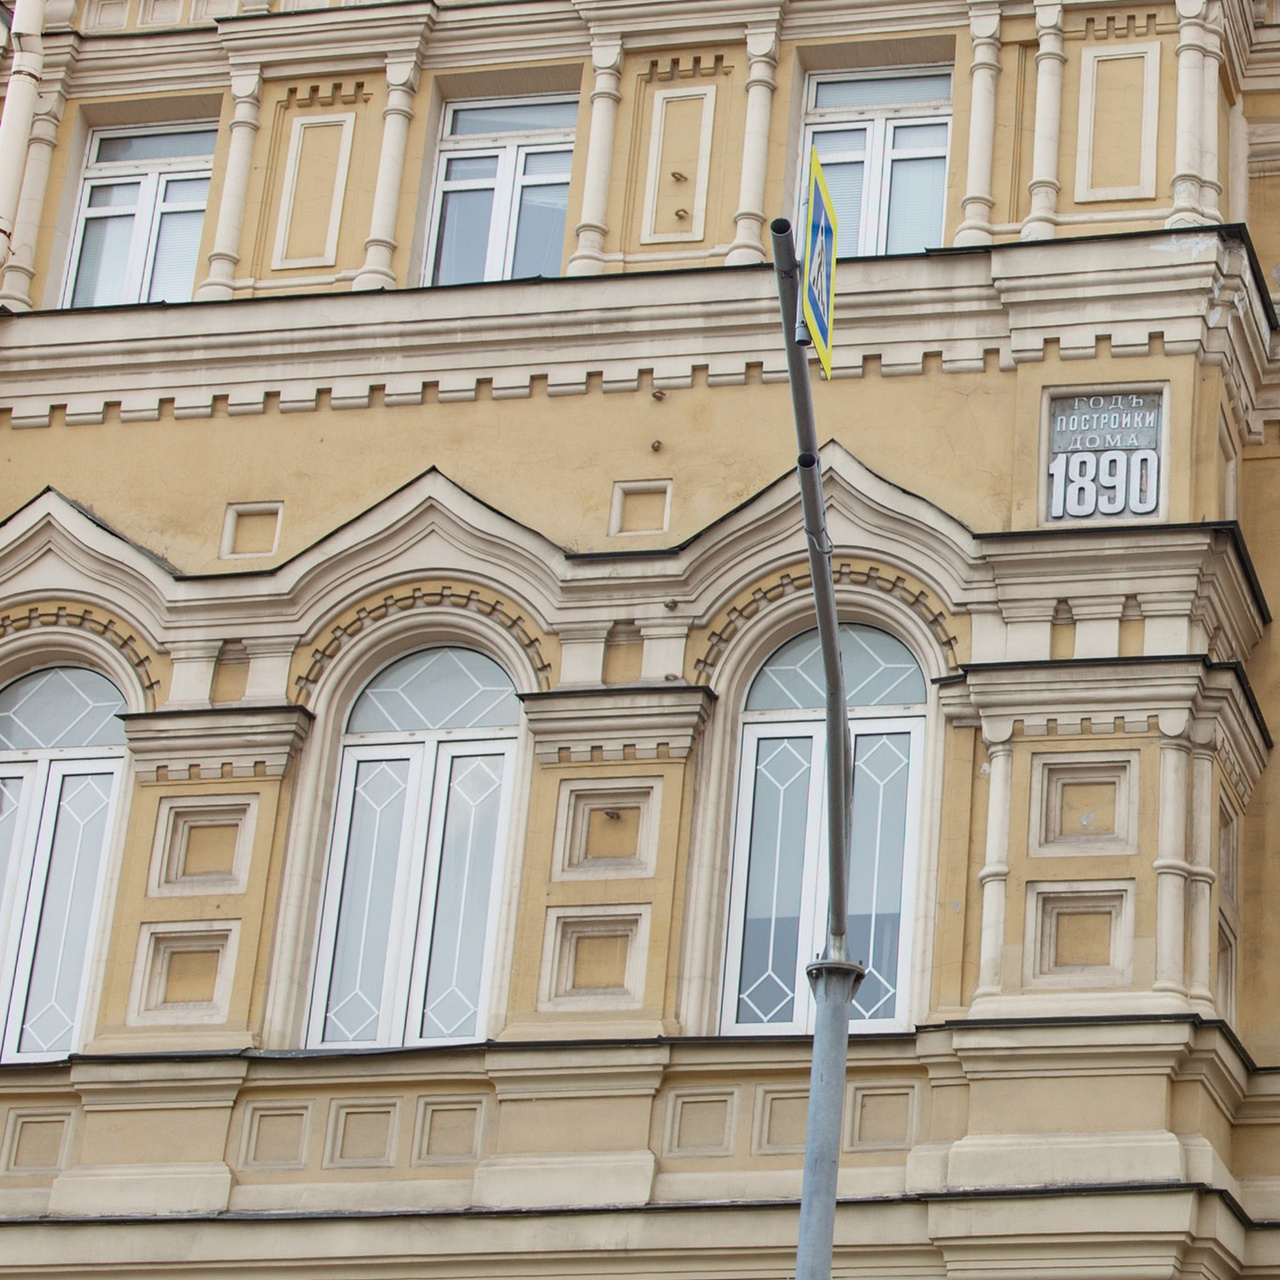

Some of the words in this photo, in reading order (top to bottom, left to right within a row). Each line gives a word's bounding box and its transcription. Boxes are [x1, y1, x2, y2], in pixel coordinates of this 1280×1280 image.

[1074, 394, 1144, 410] ГОДЪ
[1057, 410, 1155, 432] ПОСТРОЙКИ
[1068, 433, 1140, 450] ДОМА
[1049, 449, 1159, 518] 1890
